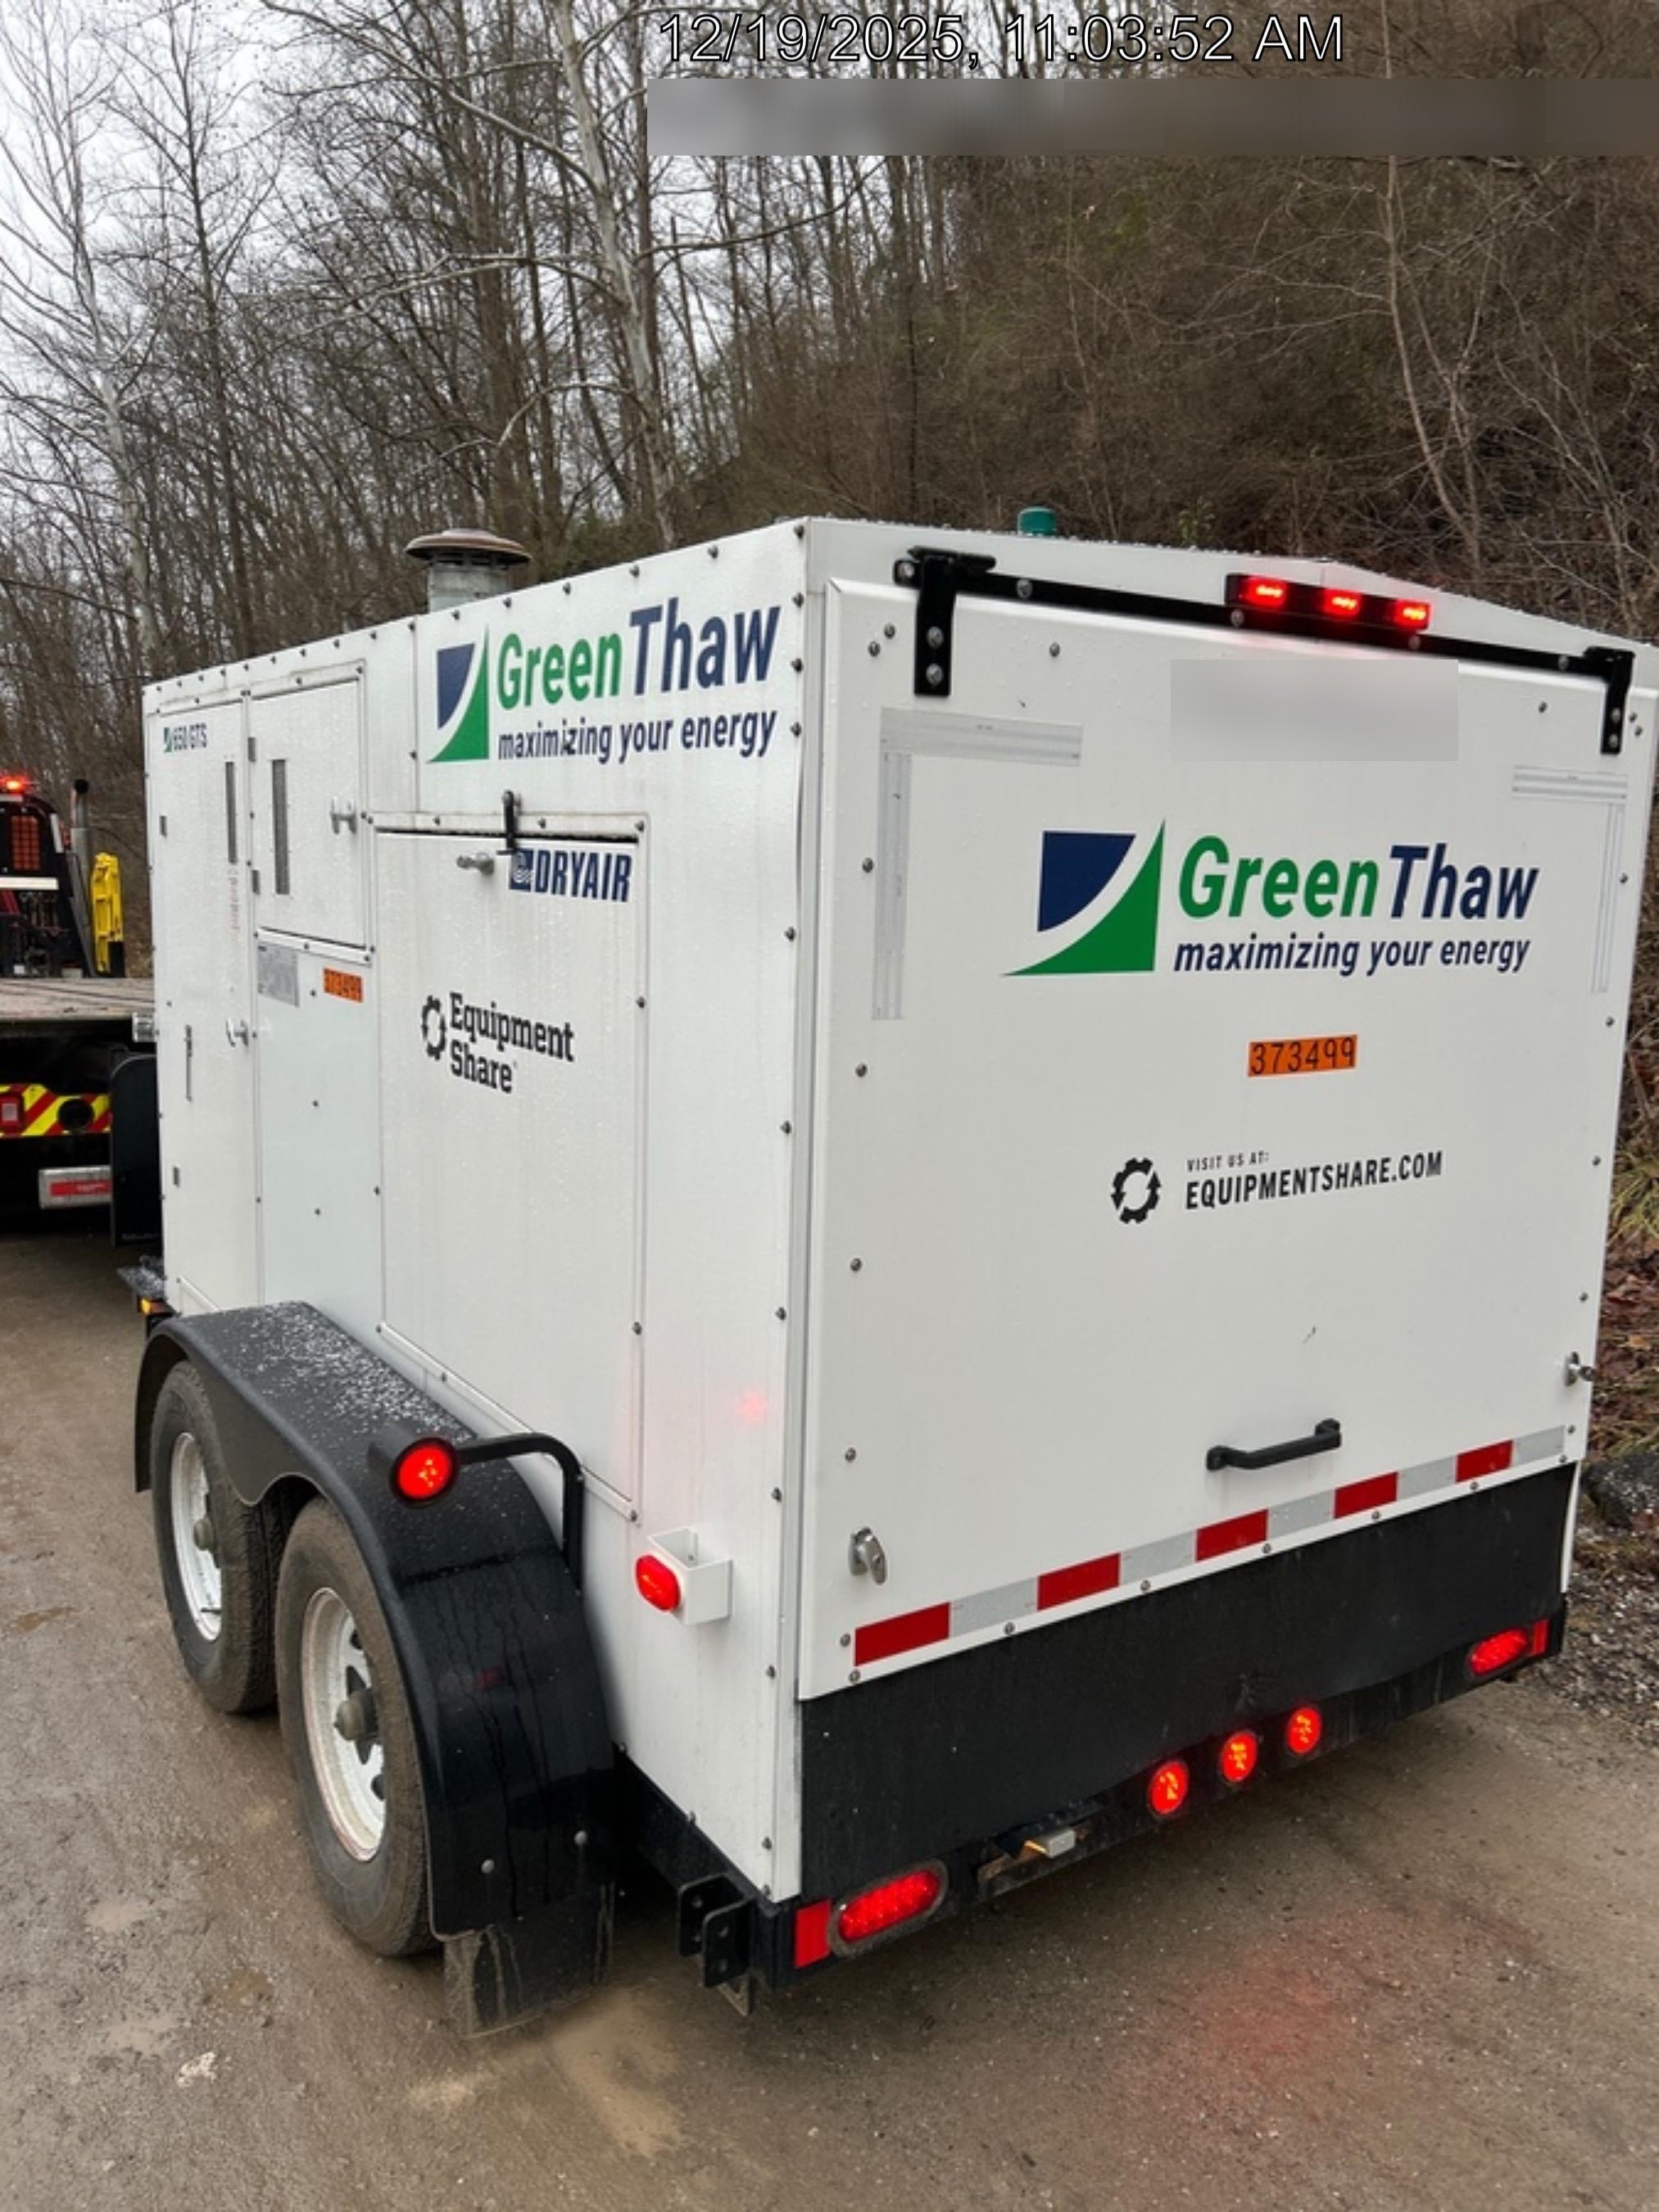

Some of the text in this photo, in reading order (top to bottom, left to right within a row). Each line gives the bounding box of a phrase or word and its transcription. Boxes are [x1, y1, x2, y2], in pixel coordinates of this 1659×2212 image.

[498, 710, 777, 764] maximizing your energy
[535, 850, 632, 902] DRYAIR
[1174, 932, 1530, 977] maximizing your energy
[450, 991, 575, 1062] Equipment
[451, 1039, 513, 1094] Share
[1250, 1036, 1355, 1075] 373499
[1185, 1150, 1443, 1210] EQUIPMENTSHARE.COM
[1187, 1150, 1269, 1172] VISIT US AT:
